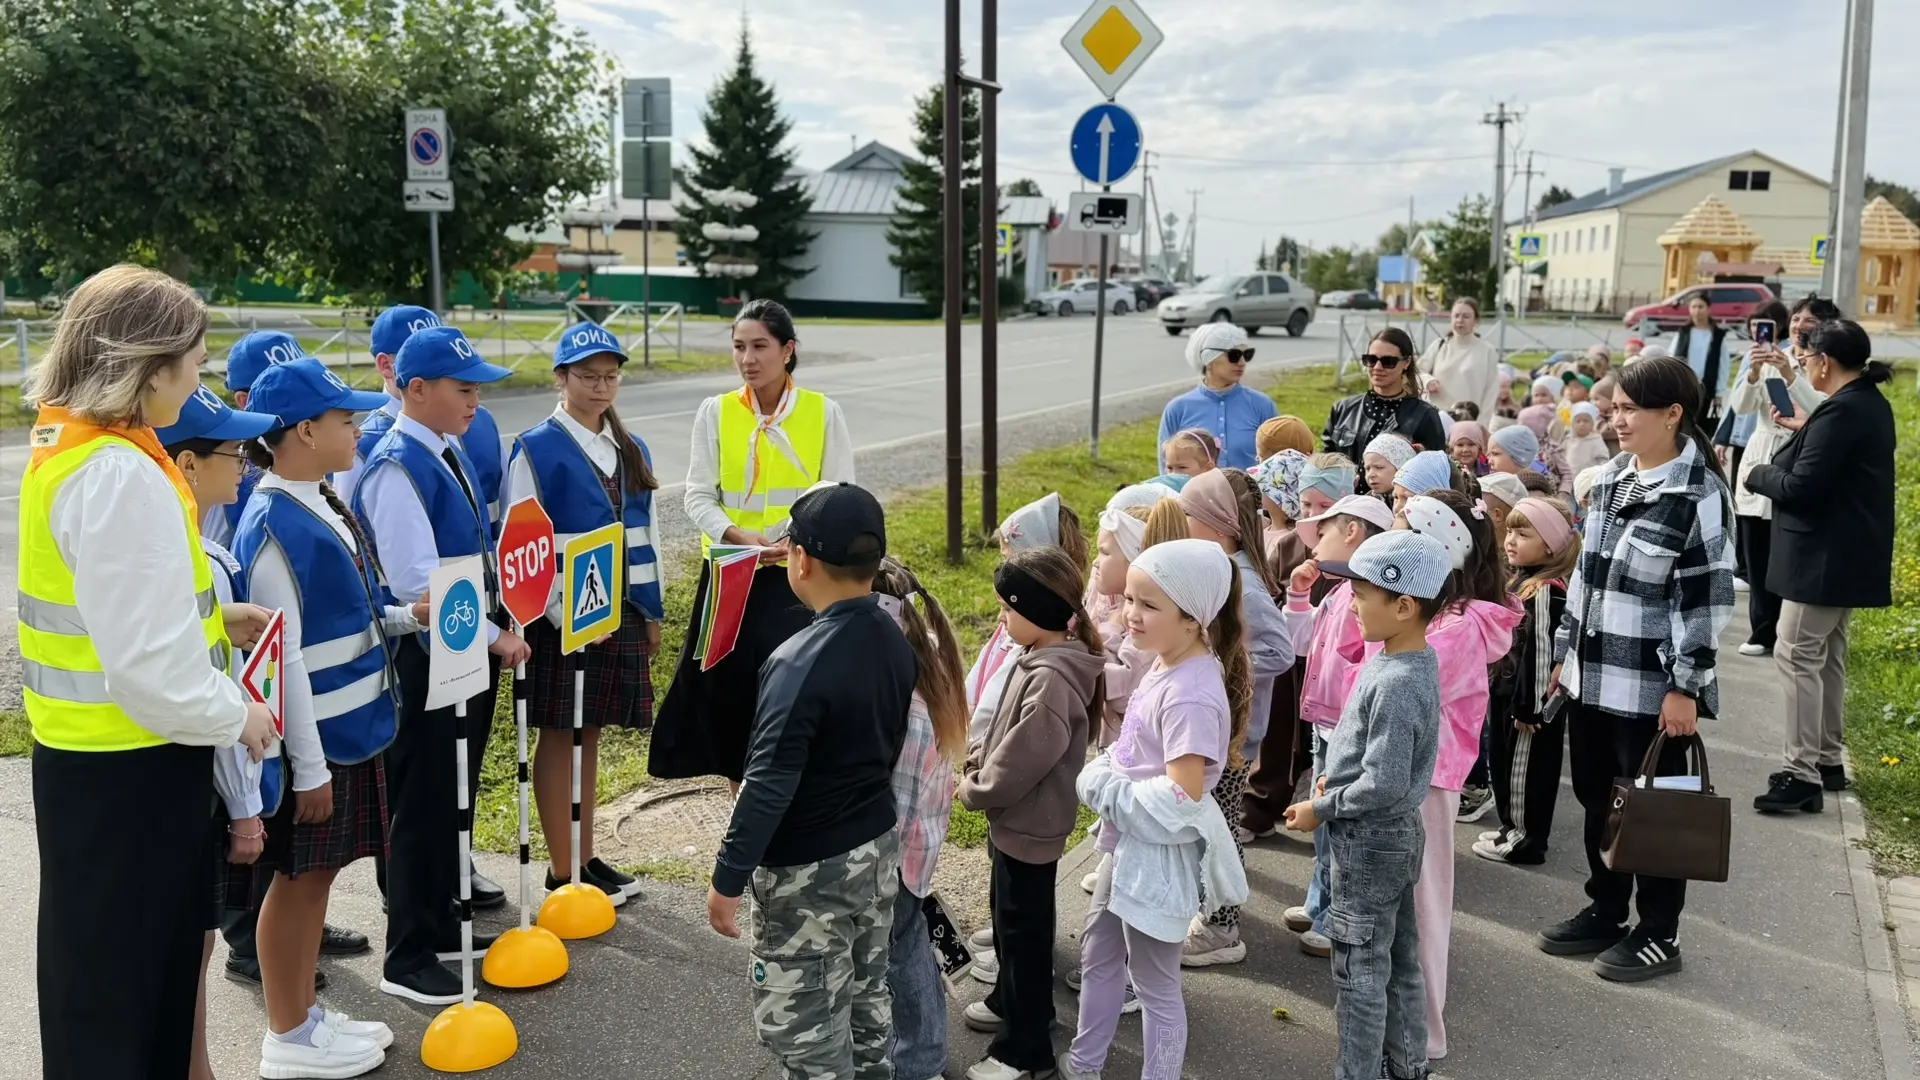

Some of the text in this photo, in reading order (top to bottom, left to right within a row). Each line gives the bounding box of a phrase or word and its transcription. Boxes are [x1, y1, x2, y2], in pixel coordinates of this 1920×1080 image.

[413, 113, 438, 124] ЗОНА
[572, 329, 613, 349] ЮИД
[264, 341, 306, 366] ЮИ
[504, 535, 550, 589] STOP
